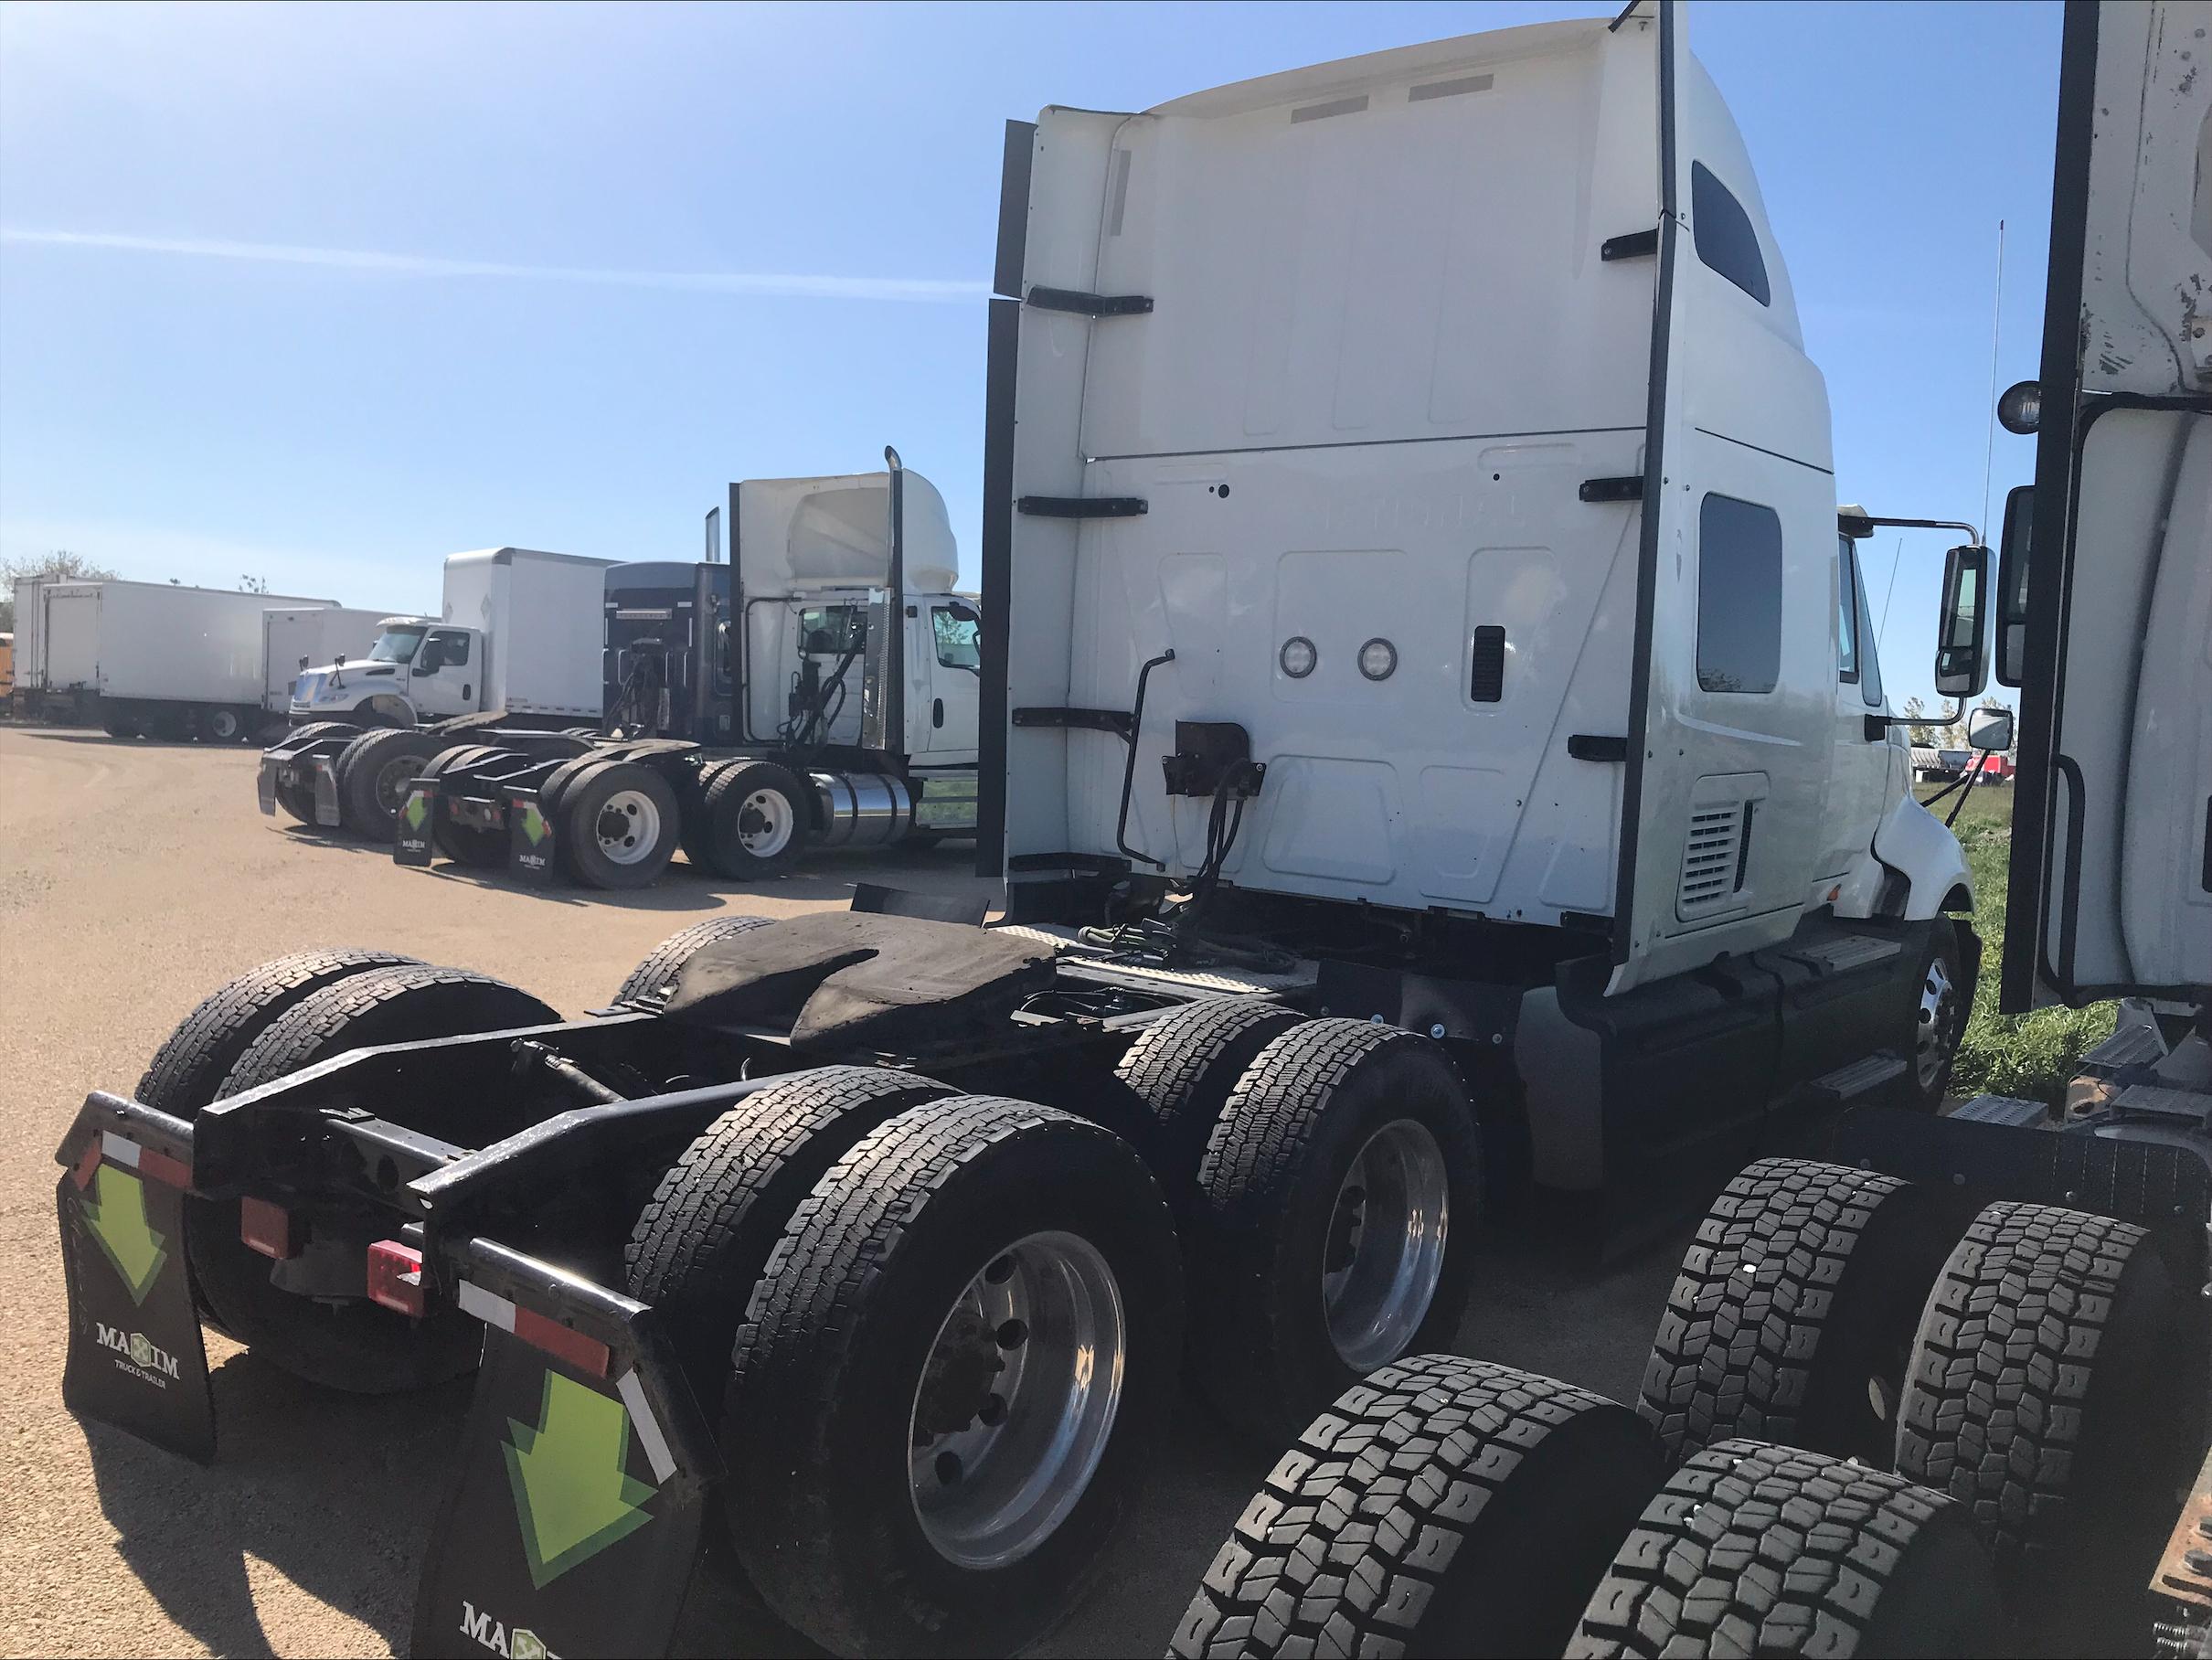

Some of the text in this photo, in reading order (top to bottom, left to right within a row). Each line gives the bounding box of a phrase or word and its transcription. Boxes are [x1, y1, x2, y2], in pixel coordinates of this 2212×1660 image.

[96, 1322, 180, 1380] MAXIM
[114, 1359, 135, 1374] TRUCK
[141, 1370, 165, 1389] TRAILER
